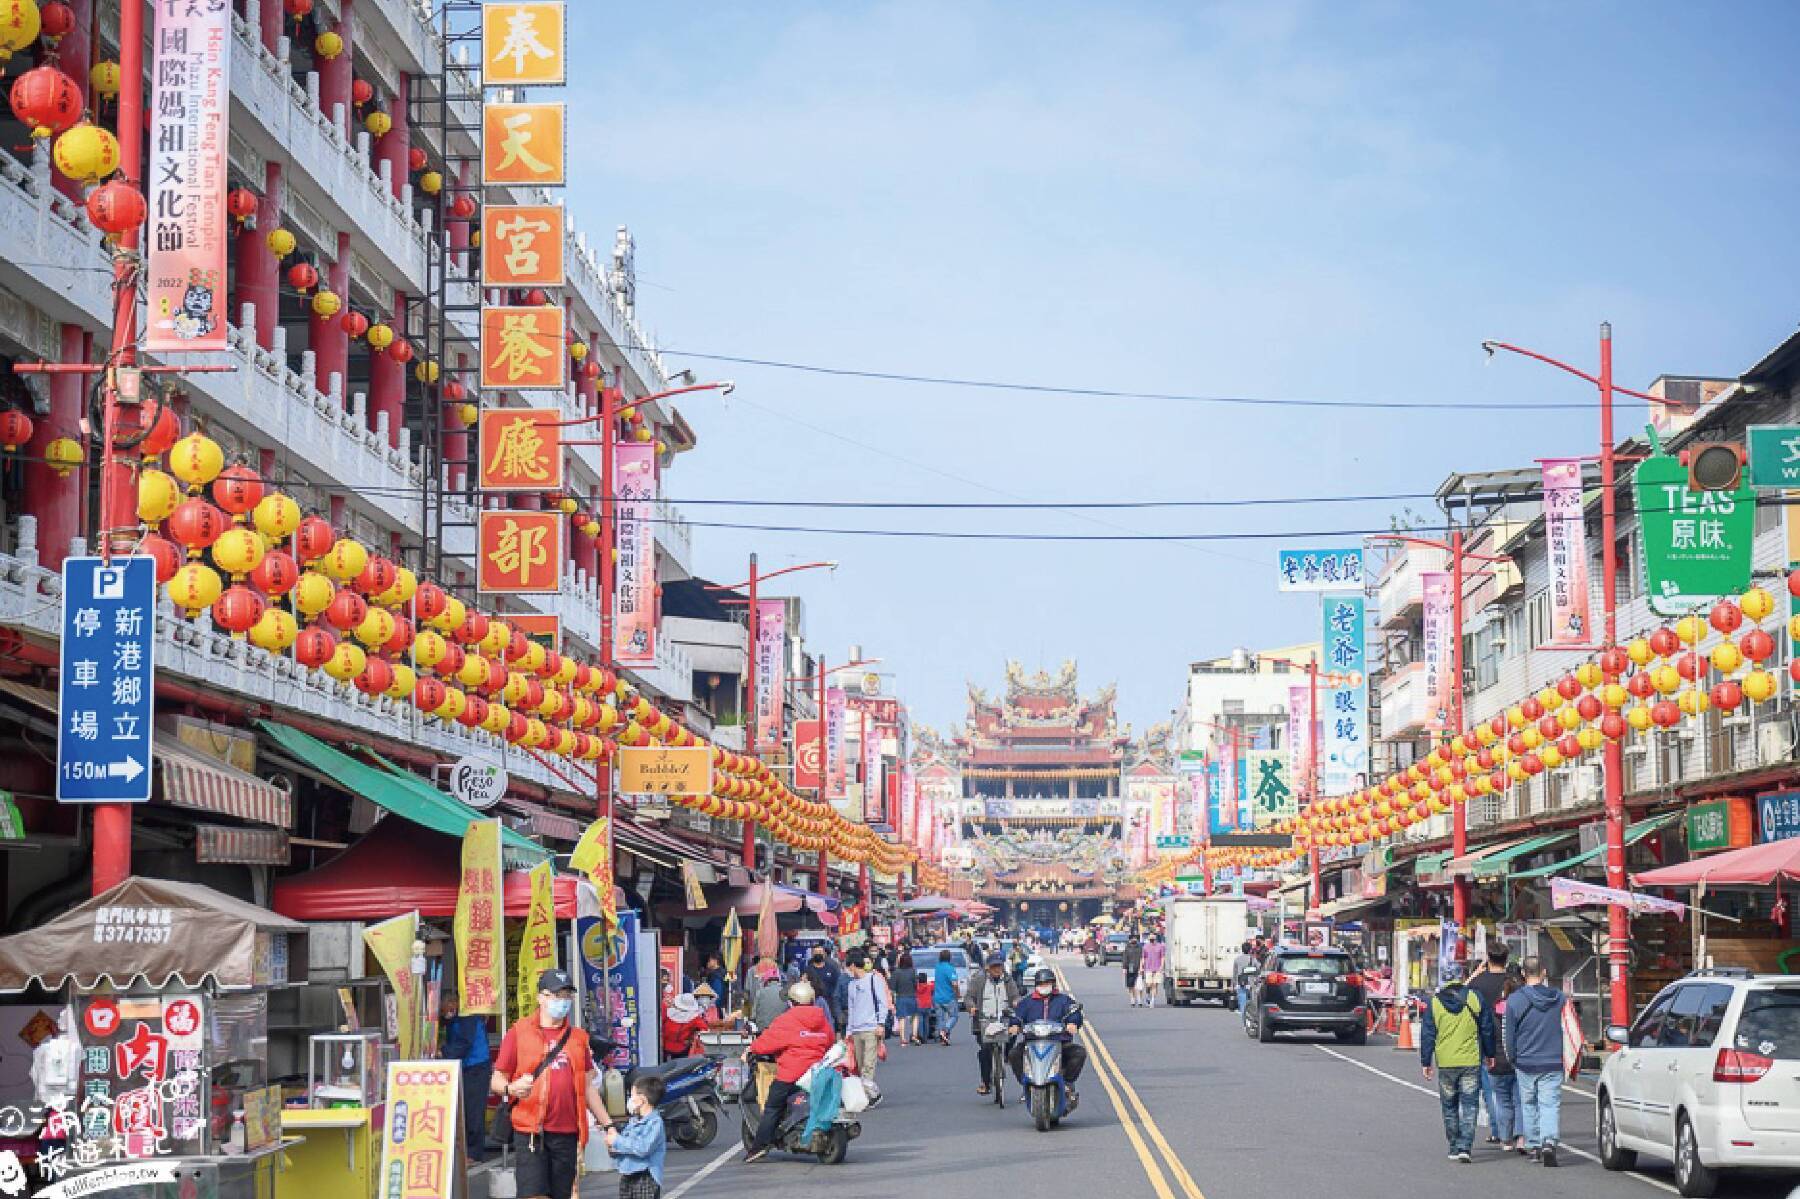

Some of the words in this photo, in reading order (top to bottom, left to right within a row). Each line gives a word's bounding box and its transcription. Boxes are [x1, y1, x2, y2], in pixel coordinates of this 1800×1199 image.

[207, 27, 224, 61] Hsin
[189, 52, 204, 90] Mazu
[202, 67, 222, 108] Kang
[157, 27, 188, 251] 國際媽祖文化節
[187, 94, 203, 188] International
[202, 112, 221, 150] Feng
[203, 153, 220, 188] Tian
[186, 193, 201, 248] Festival
[202, 192, 220, 251] Temple
[156, 277, 184, 288] 2022
[488, 9, 555, 586] 奉天宮餐廳部
[98, 571, 118, 595] P
[70, 606, 101, 741] 停車場
[112, 606, 144, 741] 新港鄉立
[63, 761, 107, 781] 150M
[1254, 759, 1290, 812] 茶
[408, 1099, 445, 1194] 肉圓
